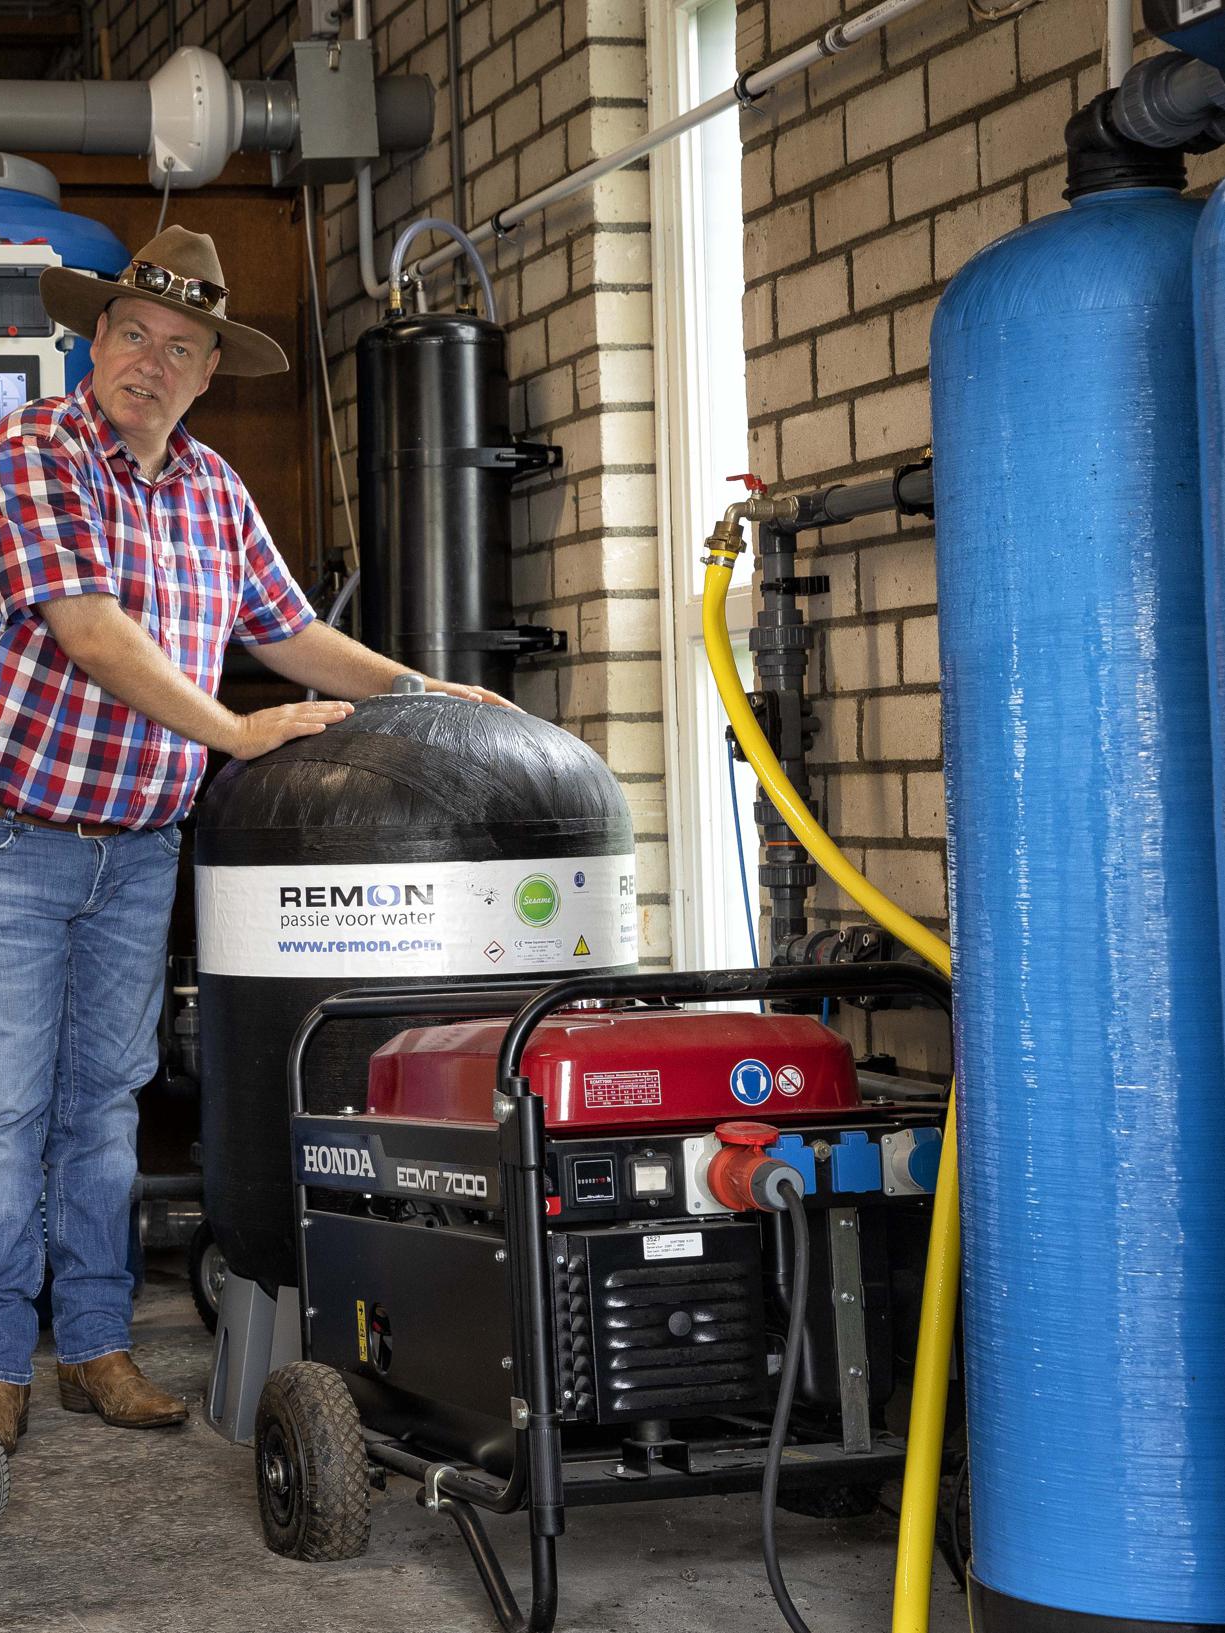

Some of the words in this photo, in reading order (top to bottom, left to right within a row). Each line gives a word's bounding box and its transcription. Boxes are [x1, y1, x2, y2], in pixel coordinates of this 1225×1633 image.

[280, 884, 434, 908] REMON
[522, 895, 553, 906] Sesame
[280, 911, 330, 929] passie
[335, 913, 376, 927] voor
[381, 911, 436, 926] water
[278, 939, 442, 953] www.remon.com
[303, 1145, 376, 1178] HONDA
[442, 1171, 487, 1197] 7000
